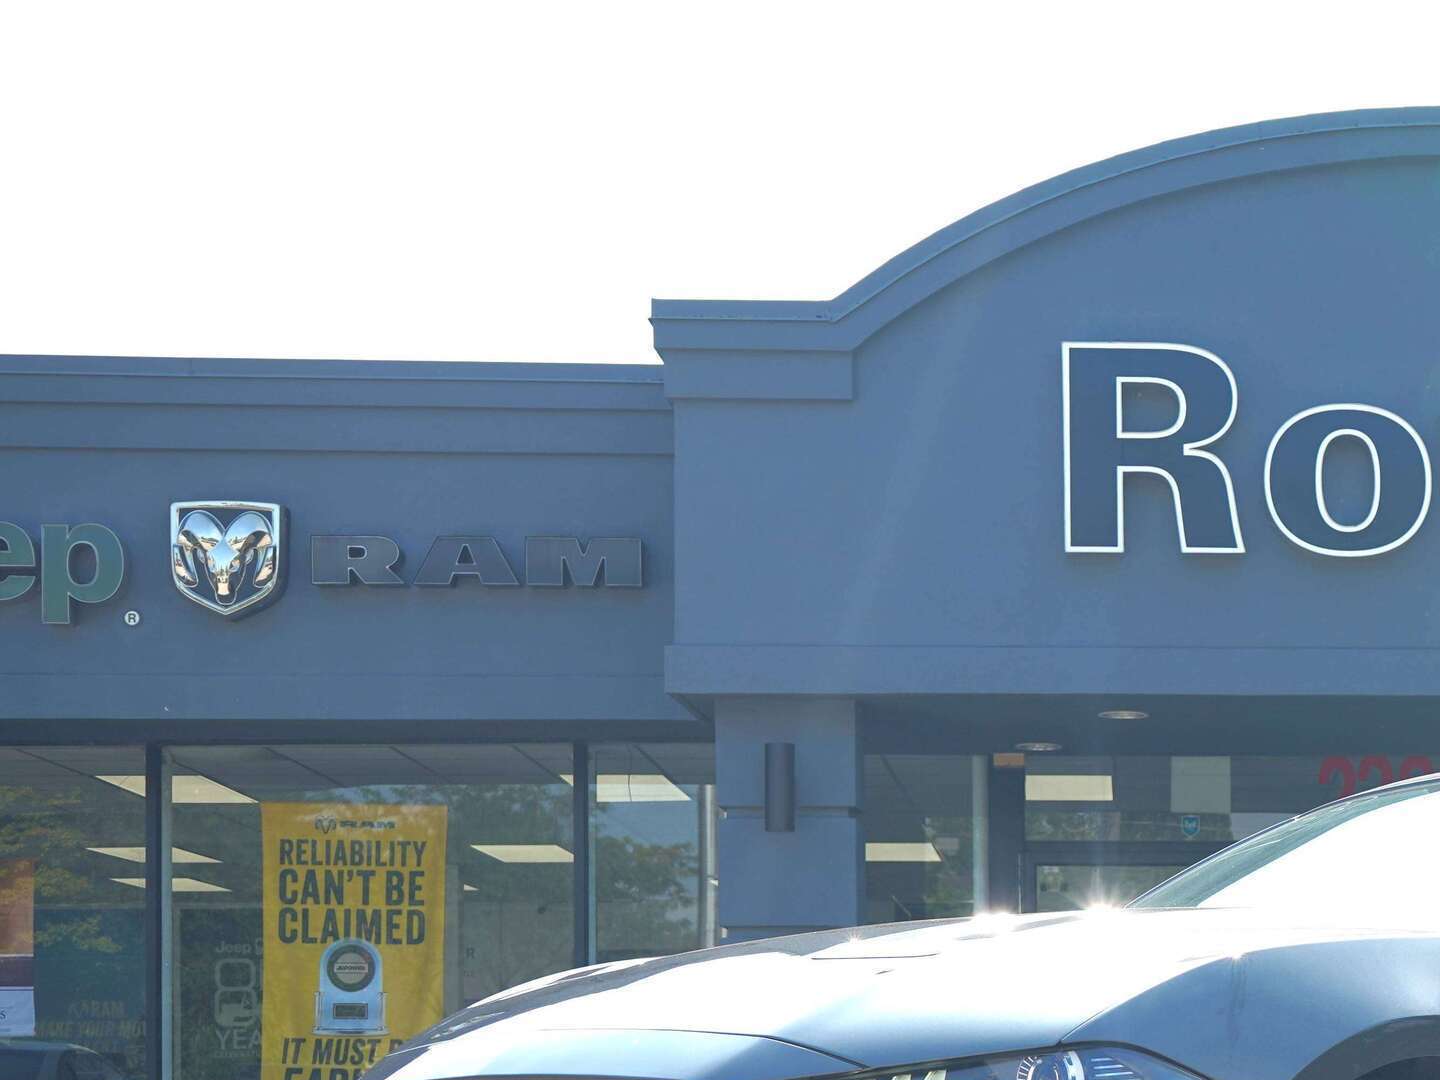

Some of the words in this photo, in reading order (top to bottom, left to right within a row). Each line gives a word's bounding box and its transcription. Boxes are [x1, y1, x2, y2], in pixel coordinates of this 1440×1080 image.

[310, 534, 643, 588] RAM
[279, 838, 427, 867] RELIABILITY
[279, 868, 376, 905] CAN'T
[386, 869, 425, 906] BE
[278, 907, 426, 945] CLAIMED
[215, 942, 251, 954] Jeep
[281, 1037, 306, 1065] IT
[311, 1037, 382, 1065] MUST
